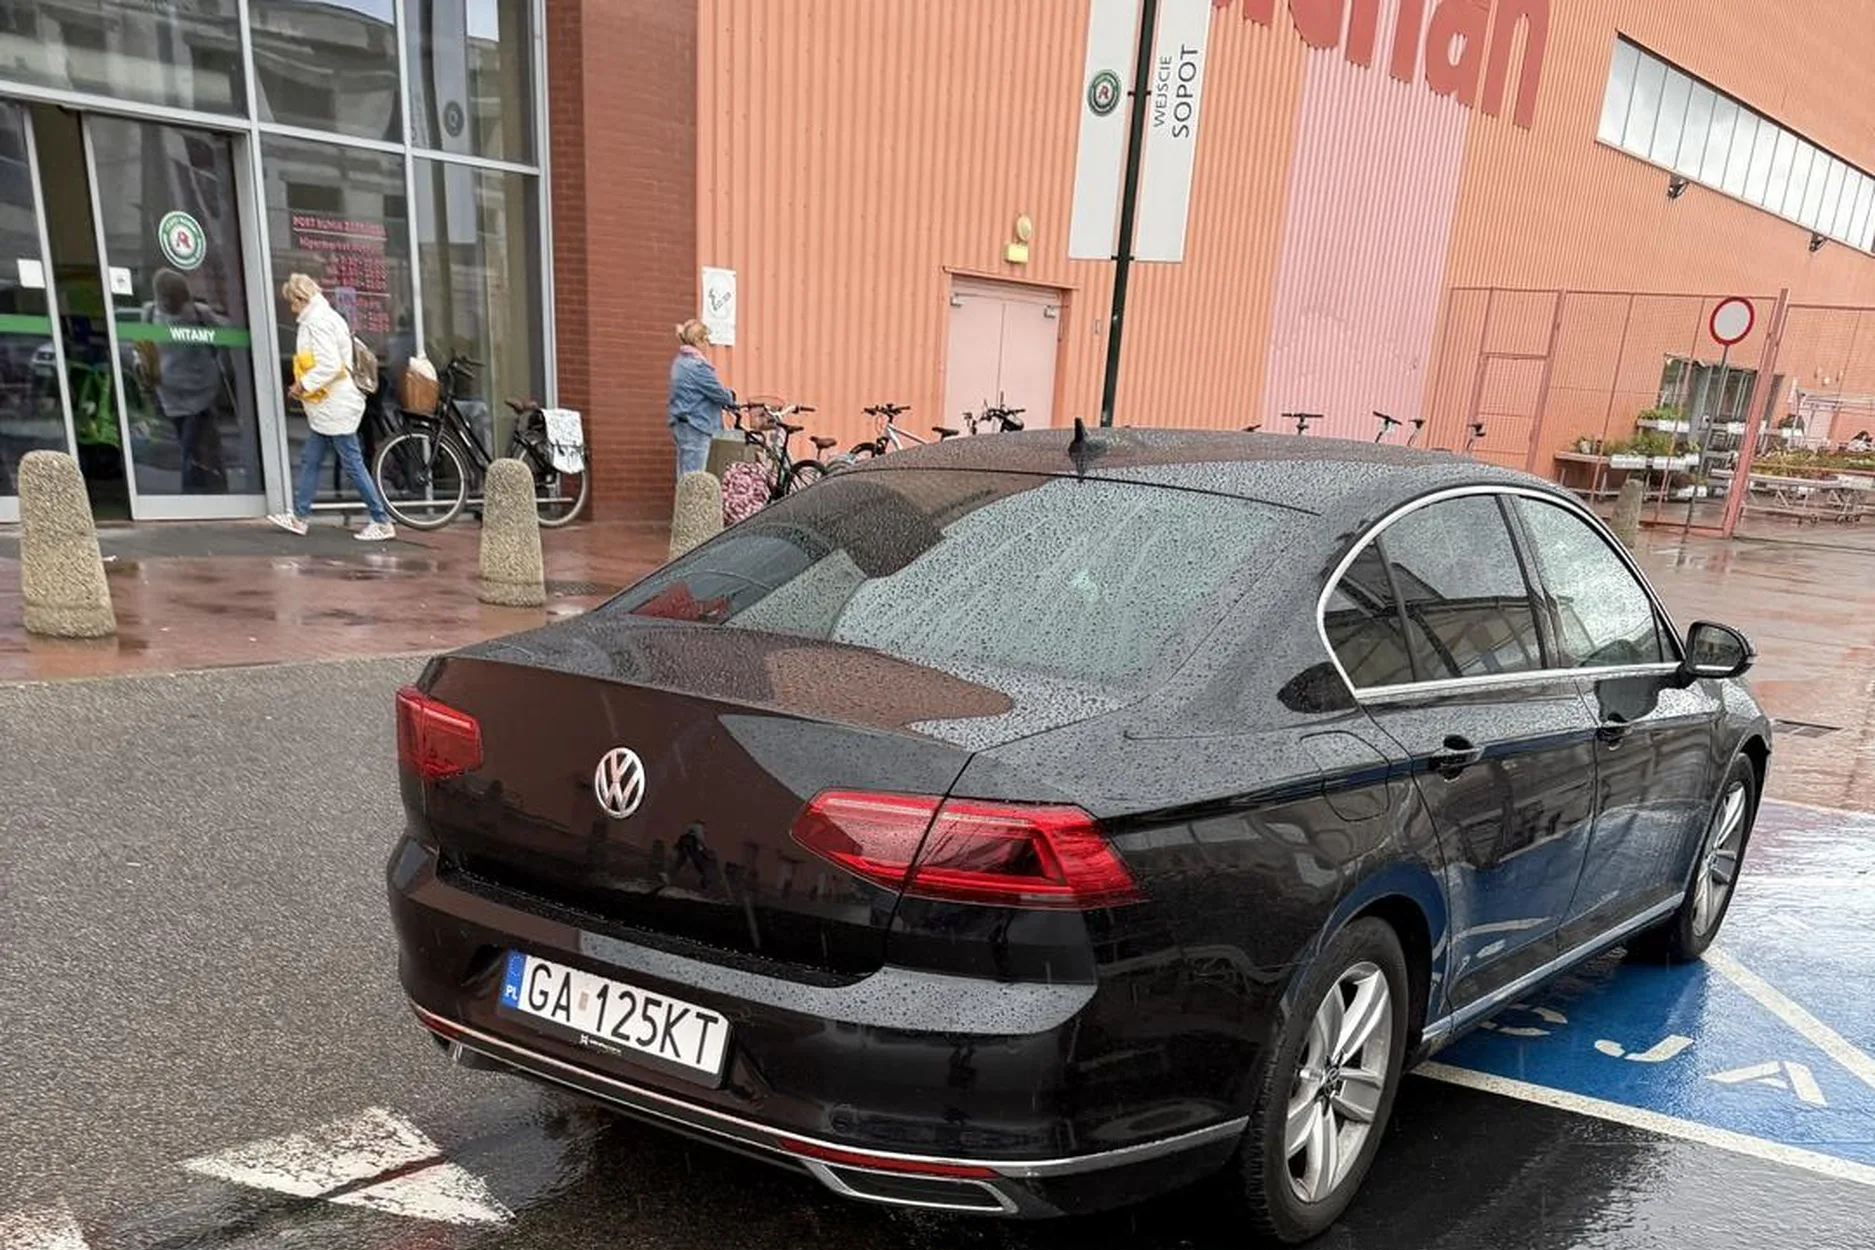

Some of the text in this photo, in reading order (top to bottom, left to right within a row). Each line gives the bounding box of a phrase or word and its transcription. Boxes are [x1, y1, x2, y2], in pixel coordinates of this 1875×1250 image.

[1172, 44, 1199, 139] SOPOT
[169, 326, 215, 343] WITAMY
[505, 984, 518, 1000] PL
[528, 963, 719, 1065] GA 125KT
